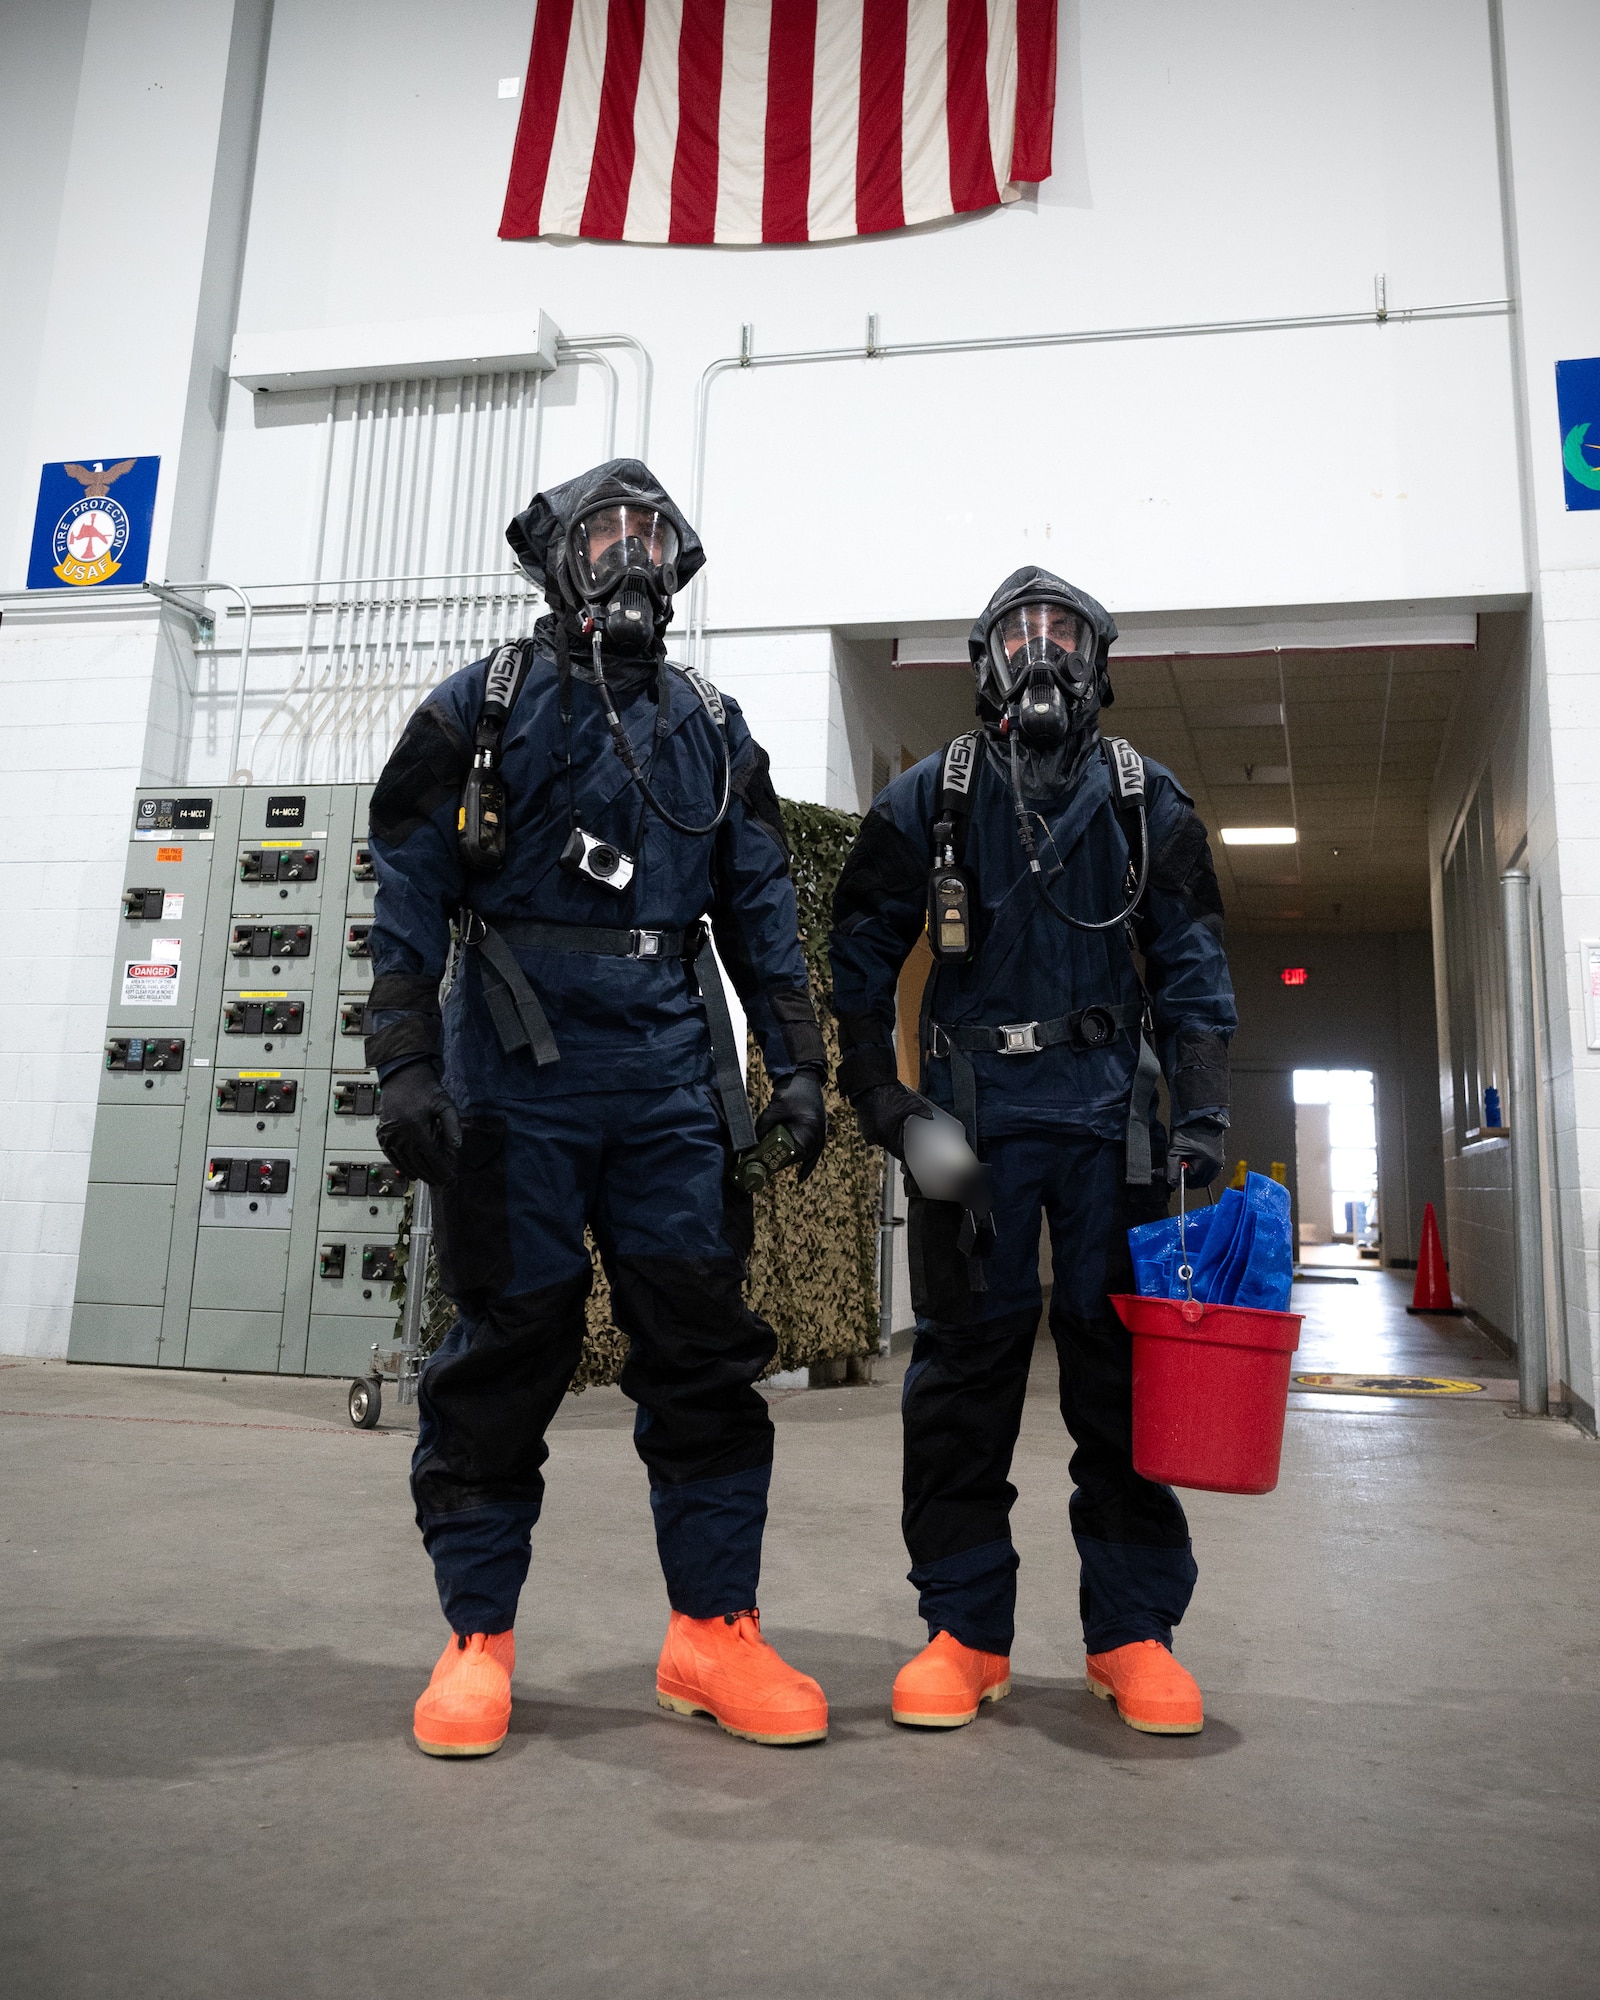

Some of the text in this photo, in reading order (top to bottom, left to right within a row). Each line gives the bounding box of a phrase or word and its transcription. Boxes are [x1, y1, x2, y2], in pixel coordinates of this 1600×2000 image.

[57, 500, 125, 552] FIRE PROTECTION
[63, 557, 109, 580] USAF
[488, 648, 519, 701] MSA
[947, 736, 972, 789] MSA
[1117, 742, 1143, 790] MSA
[179, 809, 206, 818] F4-MCC1
[271, 807, 300, 816] F4-MCC2
[134, 967, 170, 976] DANGER
[1284, 967, 1305, 985] EXIT
